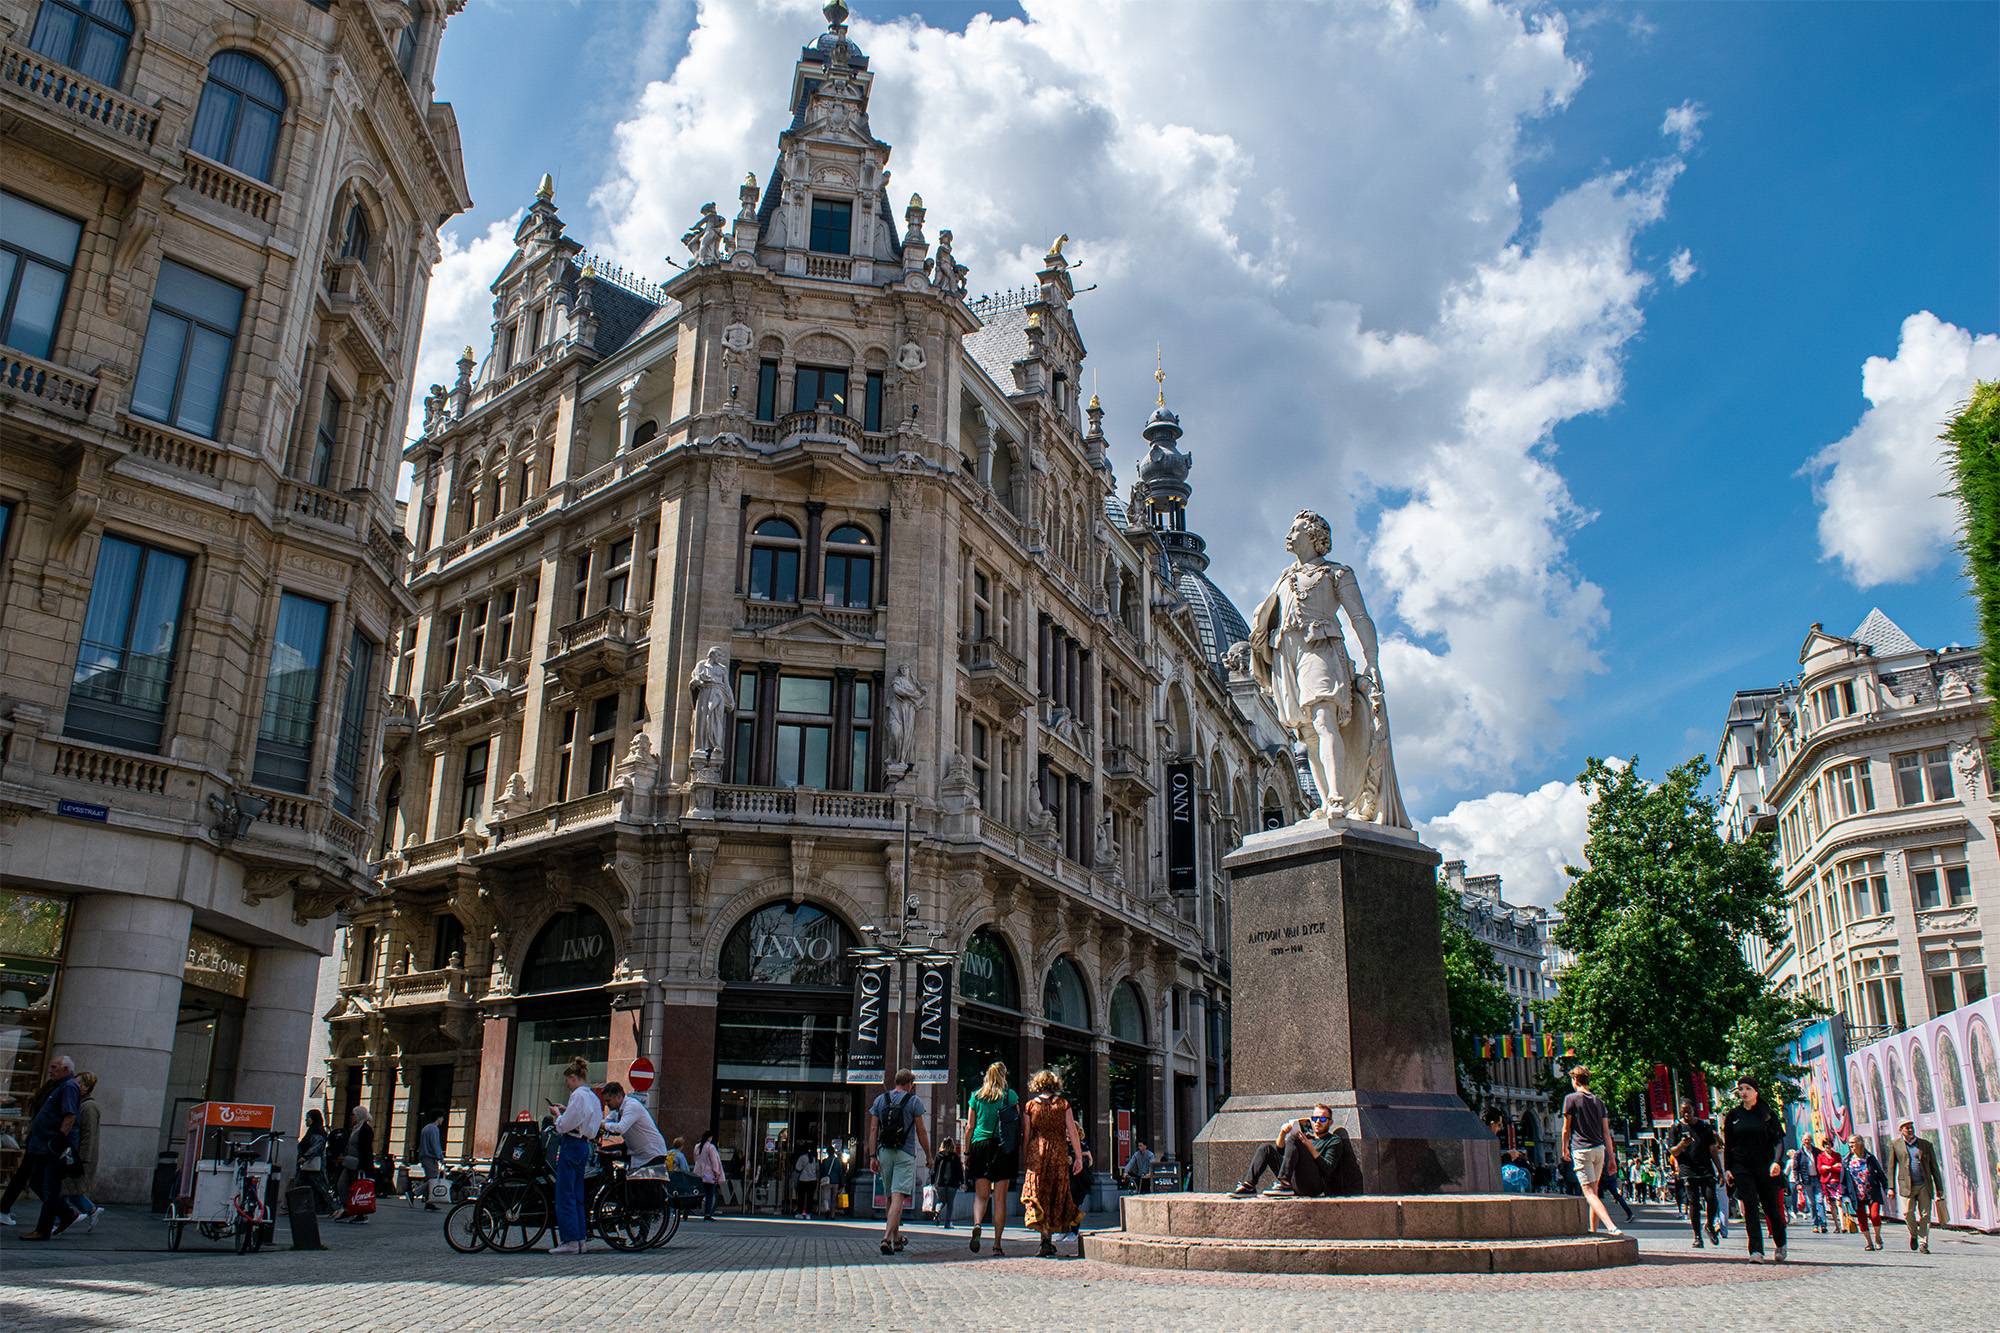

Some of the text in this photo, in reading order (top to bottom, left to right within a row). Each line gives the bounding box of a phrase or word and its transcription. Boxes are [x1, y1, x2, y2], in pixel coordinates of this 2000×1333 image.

[63, 804, 105, 817] LEYSSTRAAT
[1172, 772, 1189, 823] INNO
[560, 934, 603, 961] INNO
[752, 934, 833, 961] INNO
[188, 948, 246, 978] RA HOME
[964, 951, 993, 980] INNO
[858, 971, 882, 1045] INNO
[920, 969, 944, 1045] INNO
[1639, 1093, 1648, 1128] NESPRESSO
[1652, 1081, 1664, 1111] TOMM
[235, 1107, 263, 1117] Opnieuw
[1119, 1129, 1129, 1140] SALE
